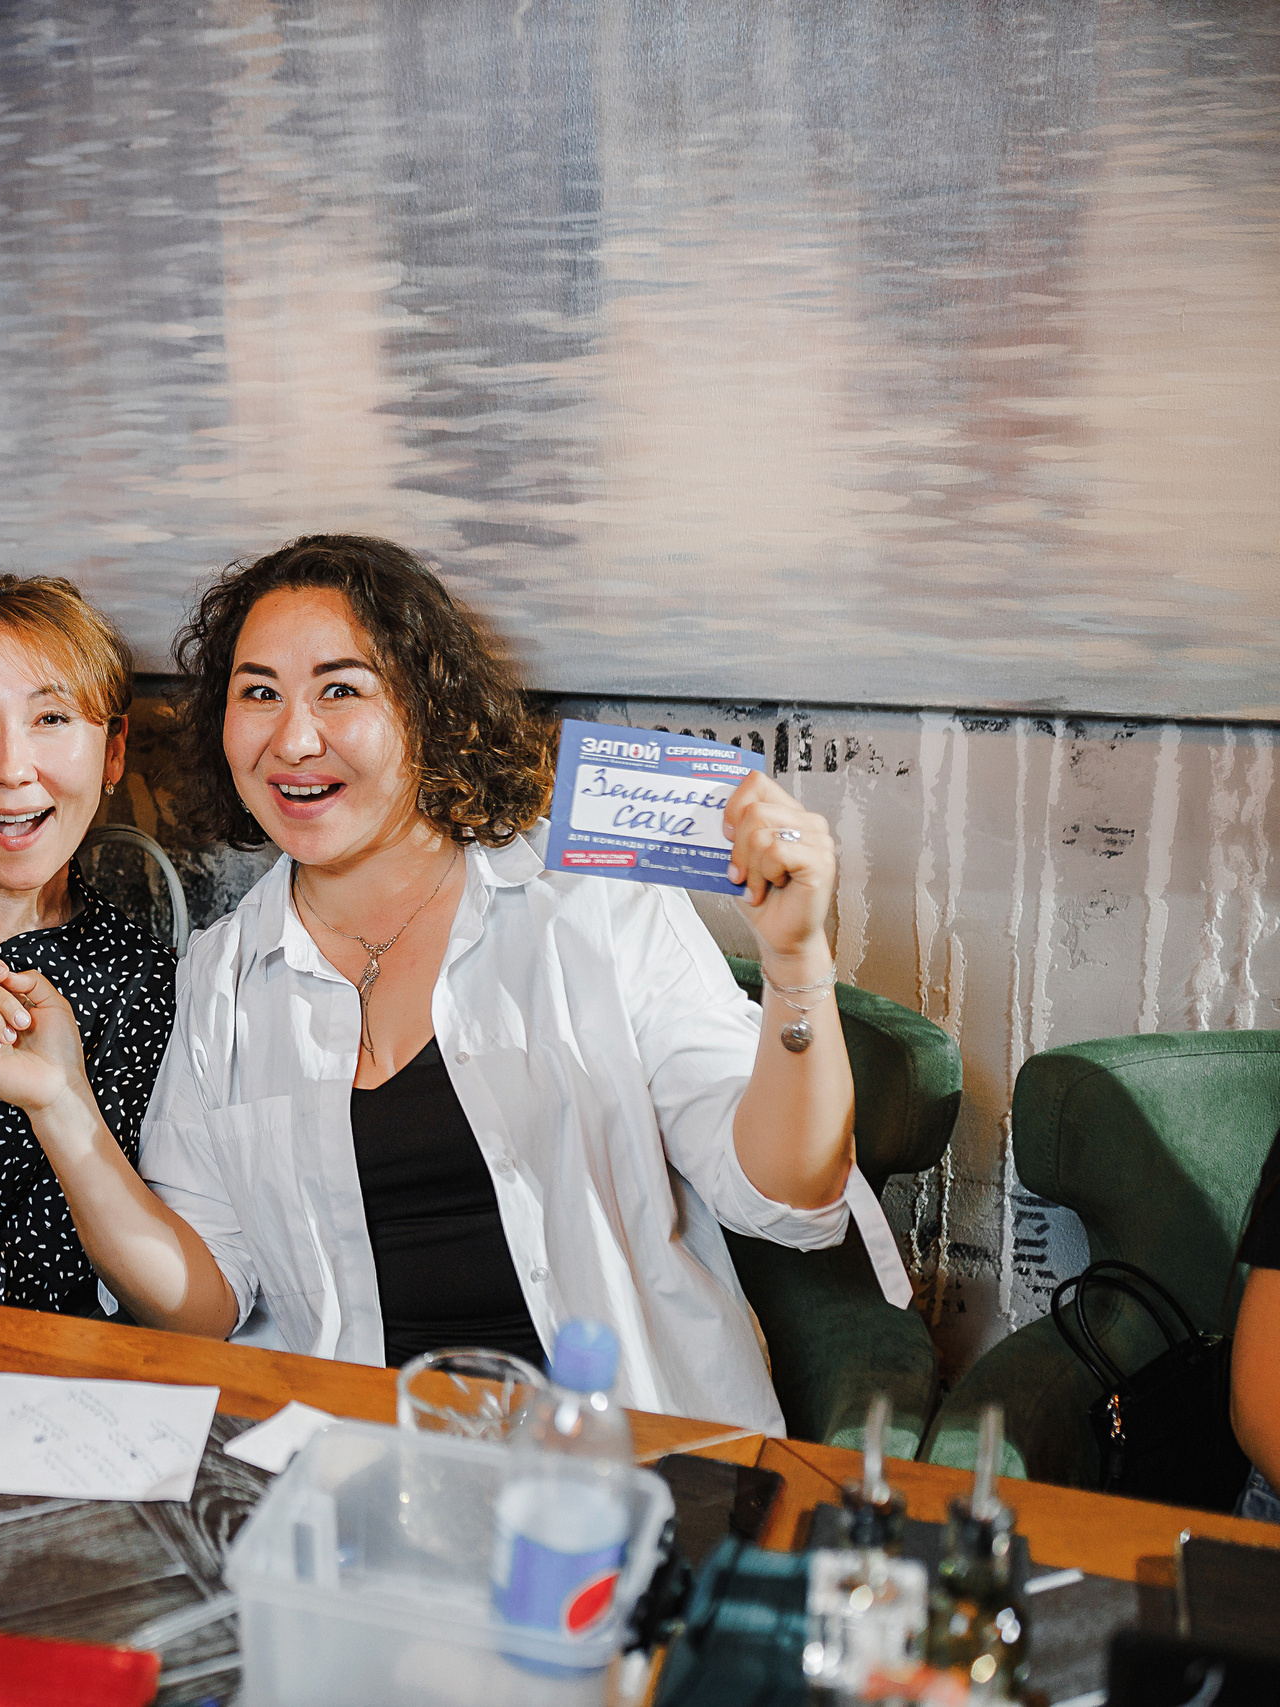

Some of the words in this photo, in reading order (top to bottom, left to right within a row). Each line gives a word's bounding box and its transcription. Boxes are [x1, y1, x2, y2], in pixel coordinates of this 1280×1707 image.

[580, 737, 661, 761] ЗАПОЙ
[665, 746, 737, 759] СЕРТИФИКАТ
[692, 763, 708, 772] НА
[711, 764, 751, 776] СКИДКУ
[568, 833, 590, 843] ДЛЯ
[592, 836, 646, 851] КОМАНДЫ
[647, 844, 661, 852] ОТ
[663, 845, 671, 853] 2
[672, 847, 688, 855] ДО
